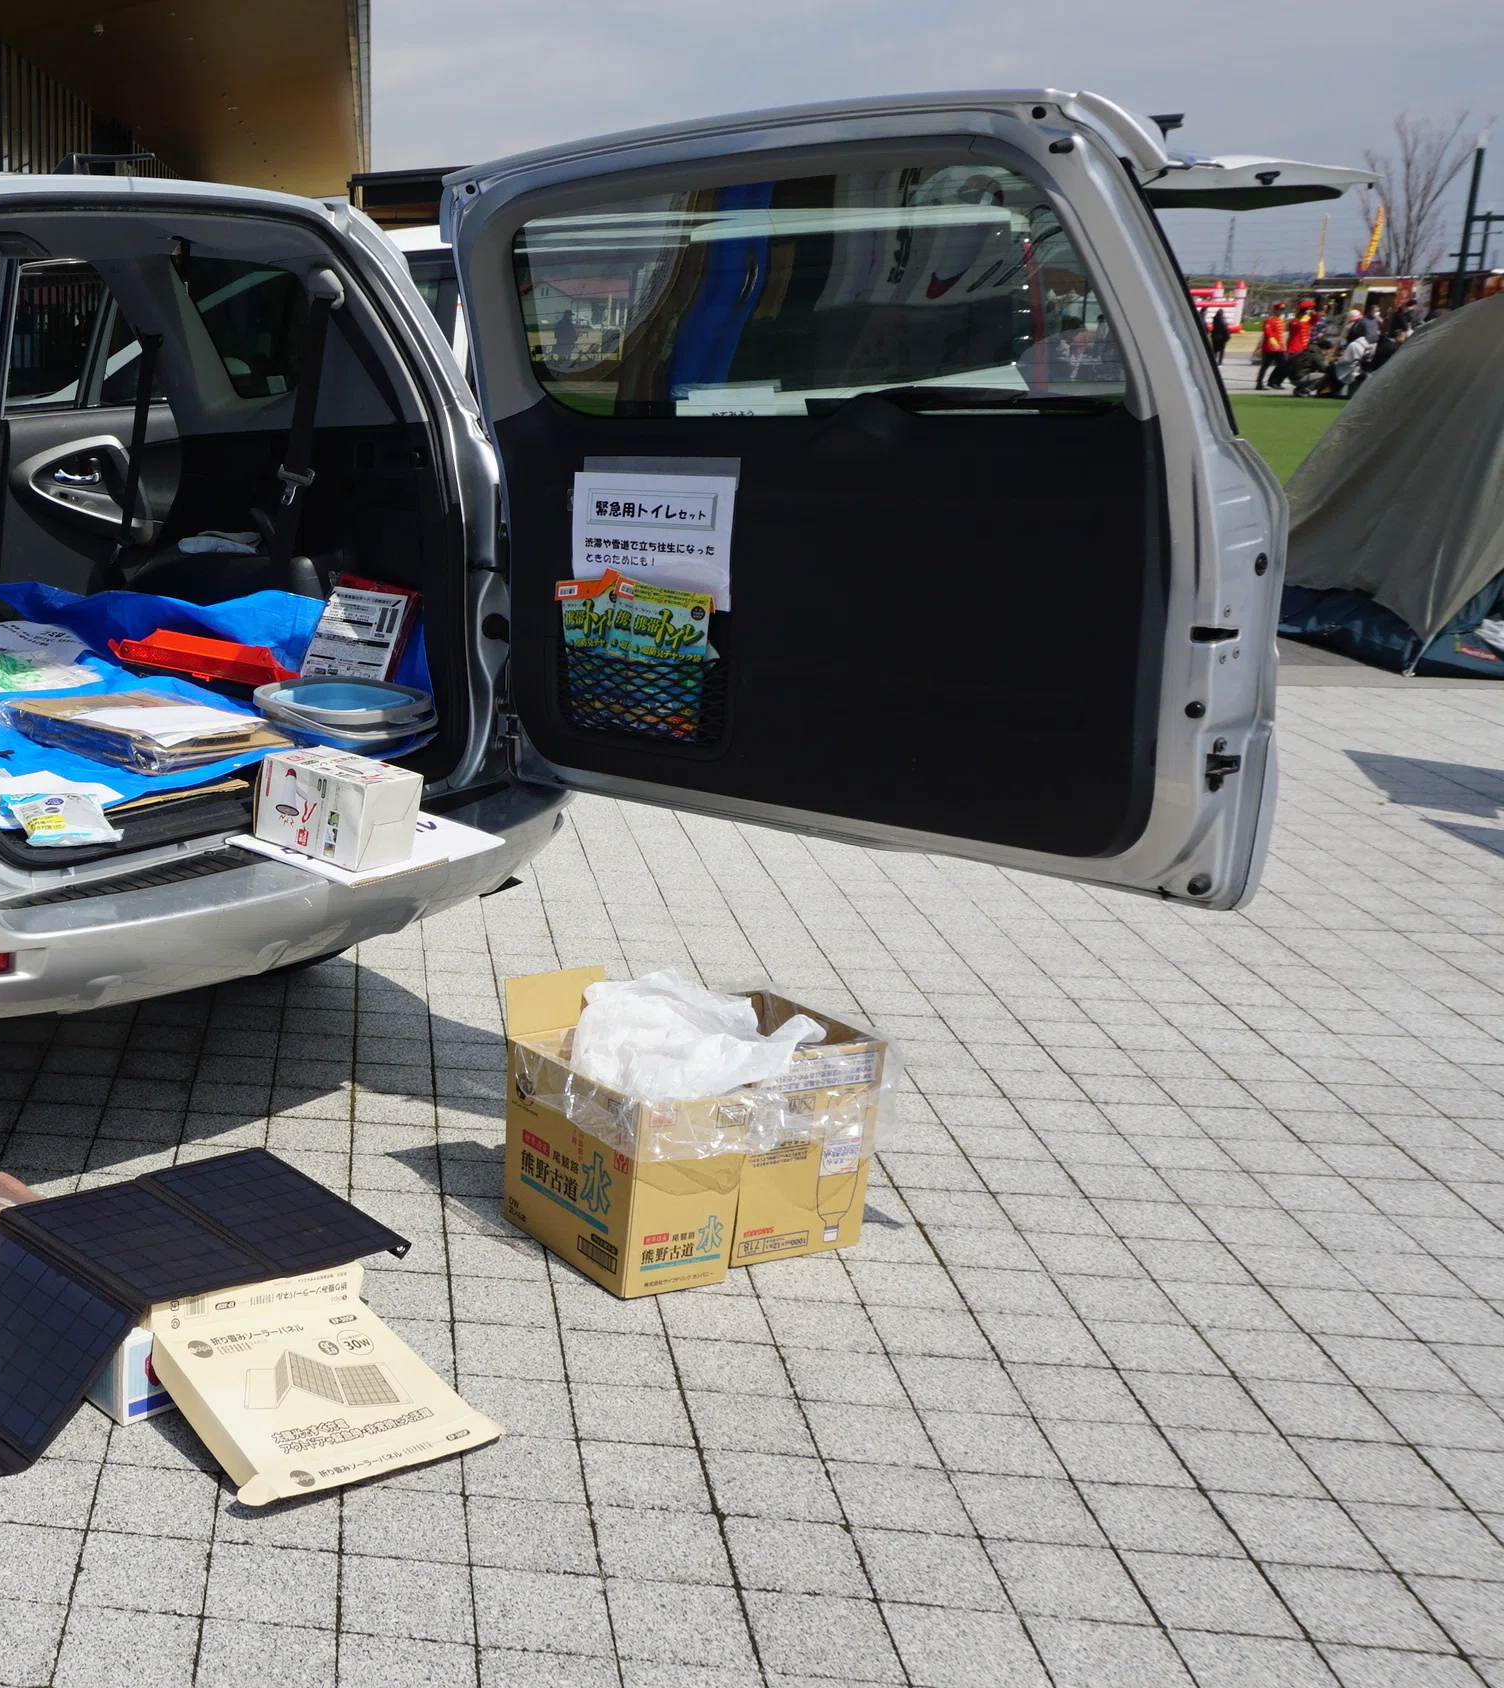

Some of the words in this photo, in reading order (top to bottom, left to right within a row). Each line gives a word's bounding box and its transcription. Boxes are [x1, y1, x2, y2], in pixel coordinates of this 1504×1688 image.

[595, 500, 707, 521] 緊急用トイレセット
[584, 537, 715, 556] 渋滞や雪道で立ち往生になった
[634, 608, 705, 648] 携帯トイレ
[521, 1148, 579, 1203] 熊野古道
[580, 1151, 612, 1214] 水
[696, 1215, 724, 1252] 水
[743, 1226, 774, 1239] SANGARIA
[641, 1243, 695, 1265] 熊野古道
[743, 1241, 760, 1252] 718
[209, 1324, 304, 1346] 折り畳みソーラーパネル
[342, 1337, 372, 1351] 30W
[318, 1450, 403, 1479] 折り畳みソーラーパネル
